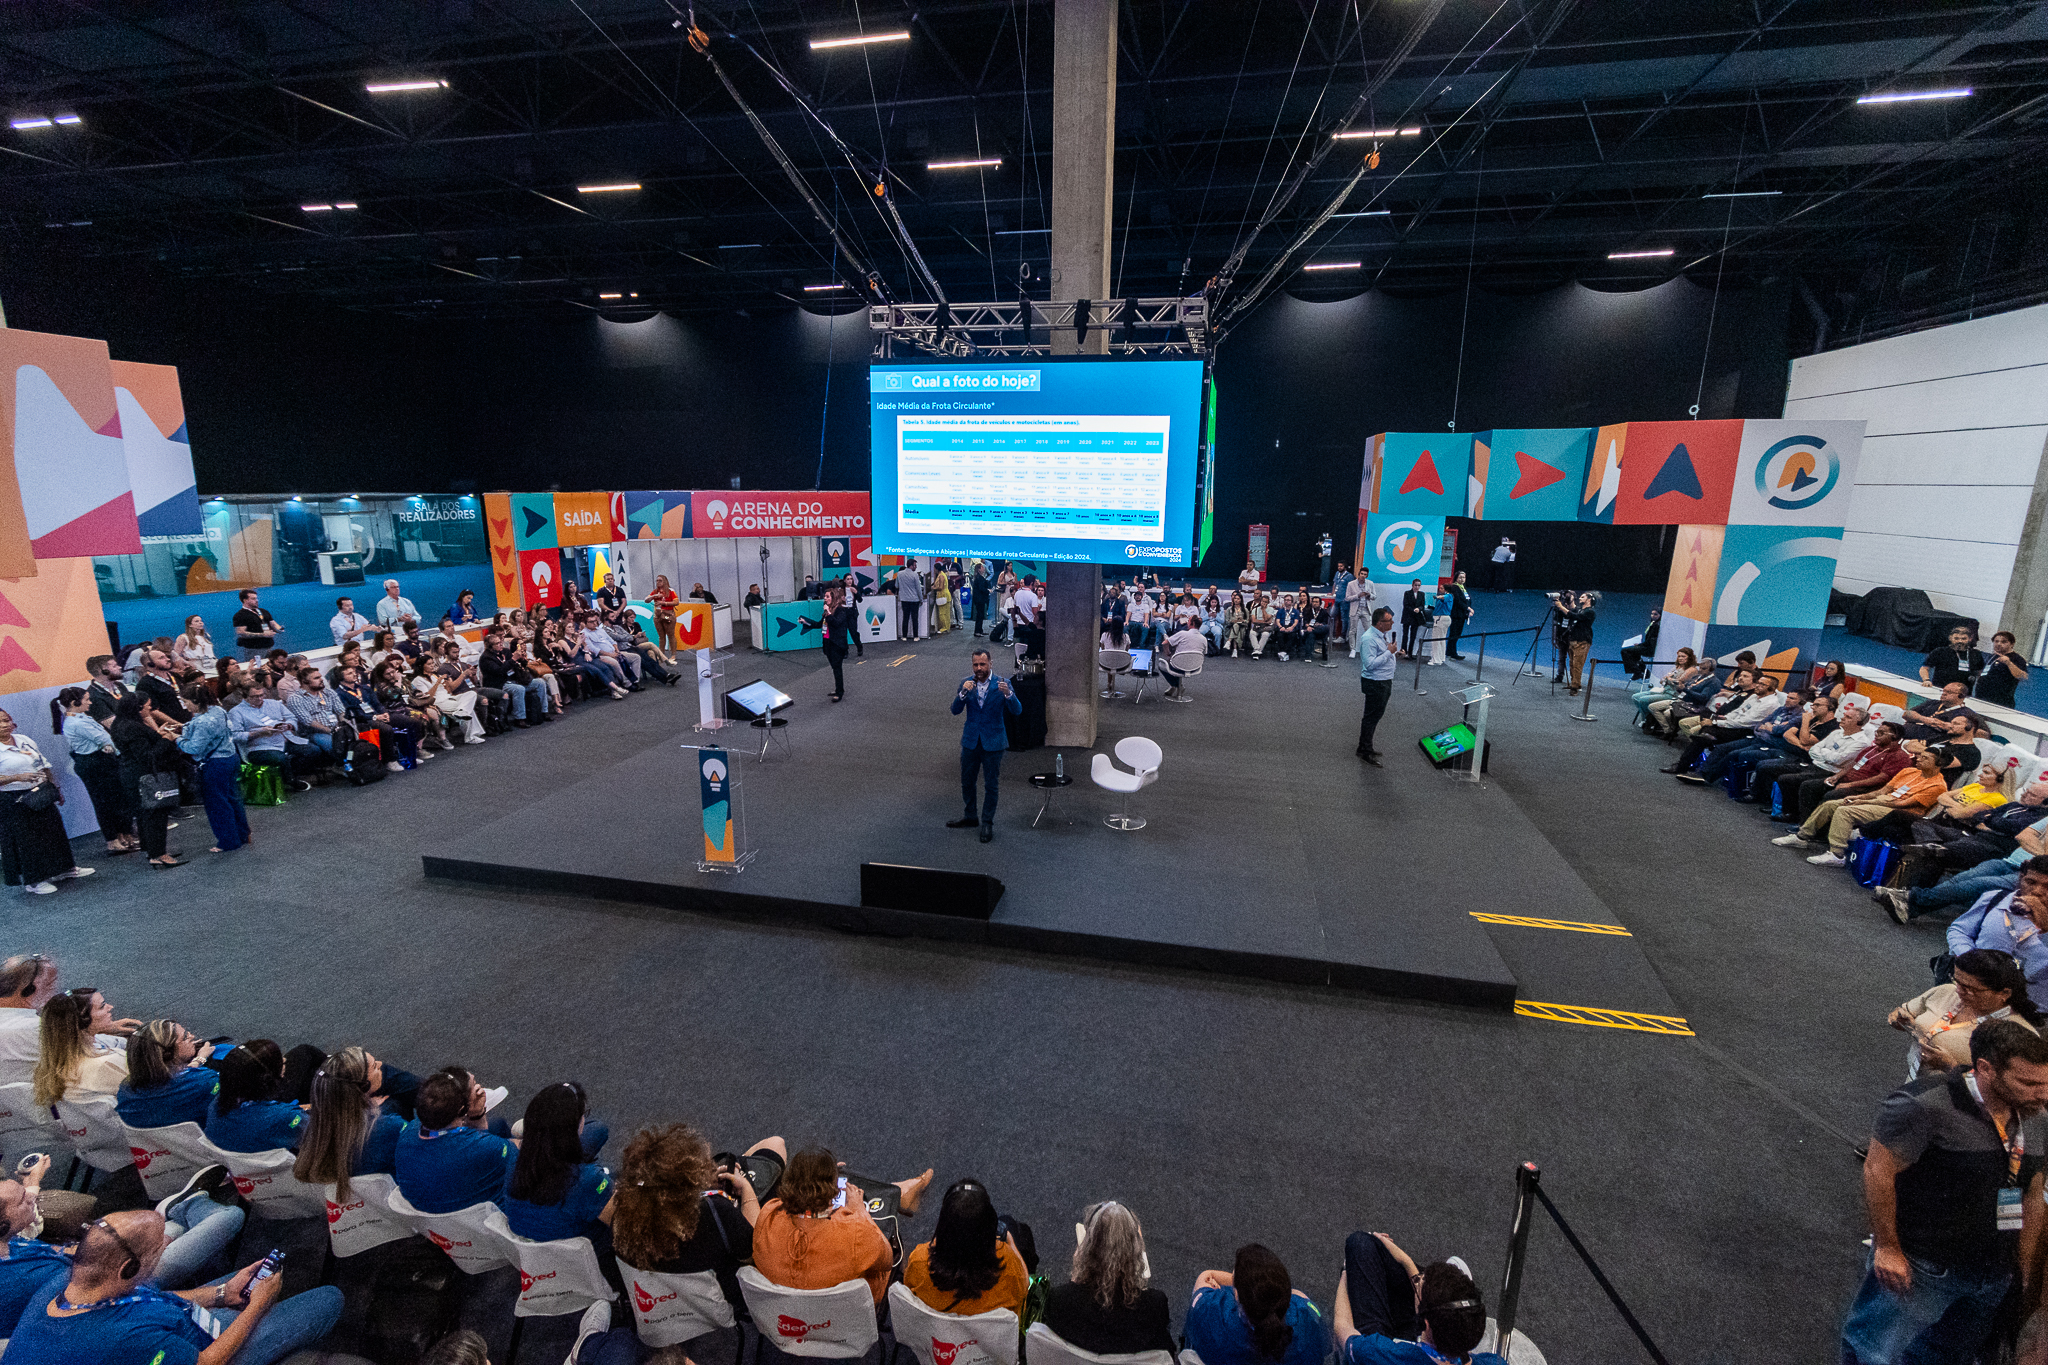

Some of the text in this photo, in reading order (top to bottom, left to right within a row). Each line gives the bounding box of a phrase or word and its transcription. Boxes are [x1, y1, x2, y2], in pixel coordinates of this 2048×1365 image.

[912, 374, 1037, 390] Qual a foto do hoje?
[876, 402, 897, 410] Idade
[898, 402, 920, 410] Média
[921, 402, 931, 410] da
[931, 402, 952, 410] Frota
[414, 501, 460, 512] SALA DOS
[730, 502, 823, 515] ARENA DO
[399, 509, 476, 522] REALIZADORES
[563, 509, 603, 527] SAÍDA
[730, 515, 865, 530] CONHECIMENTO
[1018, 551, 1048, 559] Circulante
